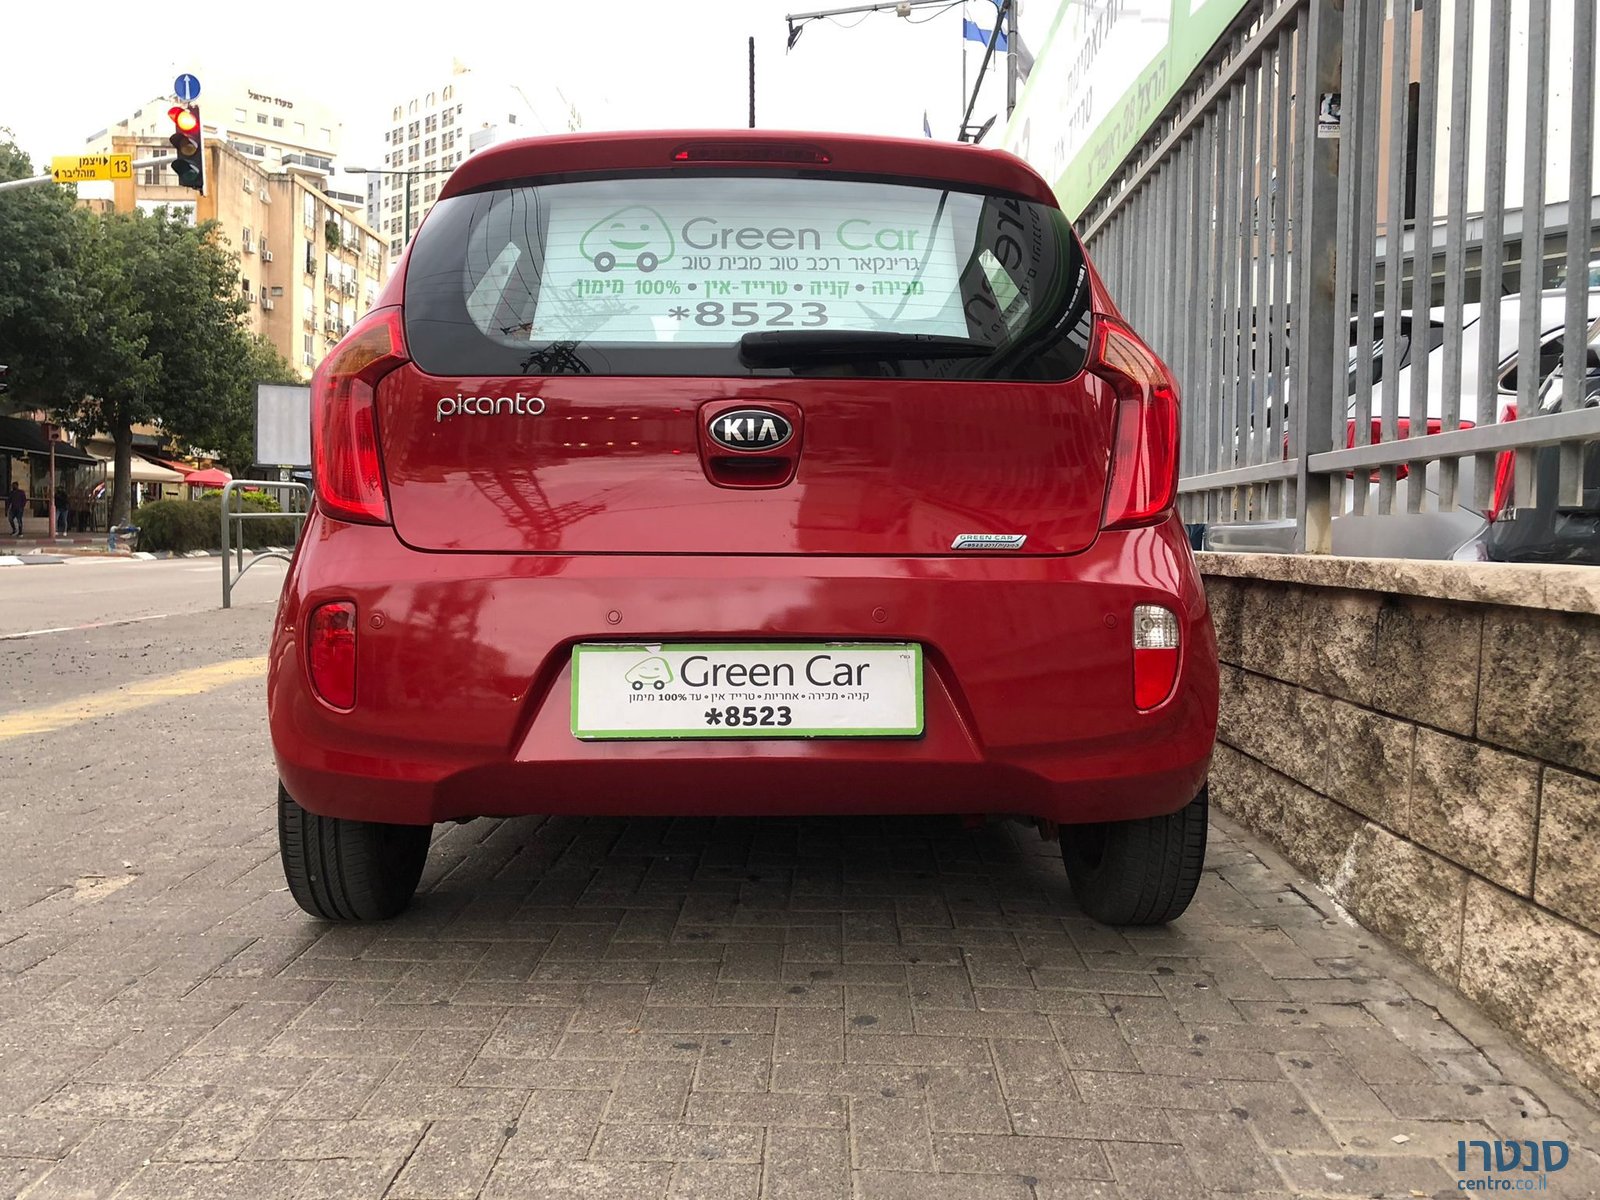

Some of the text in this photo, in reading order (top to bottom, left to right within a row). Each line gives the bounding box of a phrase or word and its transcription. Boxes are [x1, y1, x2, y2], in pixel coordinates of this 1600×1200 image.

[1137, 60, 1167, 121] הרצל
[1123, 94, 1137, 143] 28
[62, 167, 96, 178] מוהליבר
[79, 157, 102, 168] ויצמן
[115, 160, 128, 173] 13
[681, 216, 920, 252] Green Car
[682, 256, 921, 272] גרינקאר רכב טוב מבית טוב
[576, 278, 925, 298] מכירה קניה טרייד-אין 100% מימון
[436, 392, 546, 422] picanto
[723, 417, 779, 442] KIA
[680, 654, 870, 688] Green Car
[629, 692, 870, 703] קניה מכירה אחריות טרייד אין עד 100% מימון
